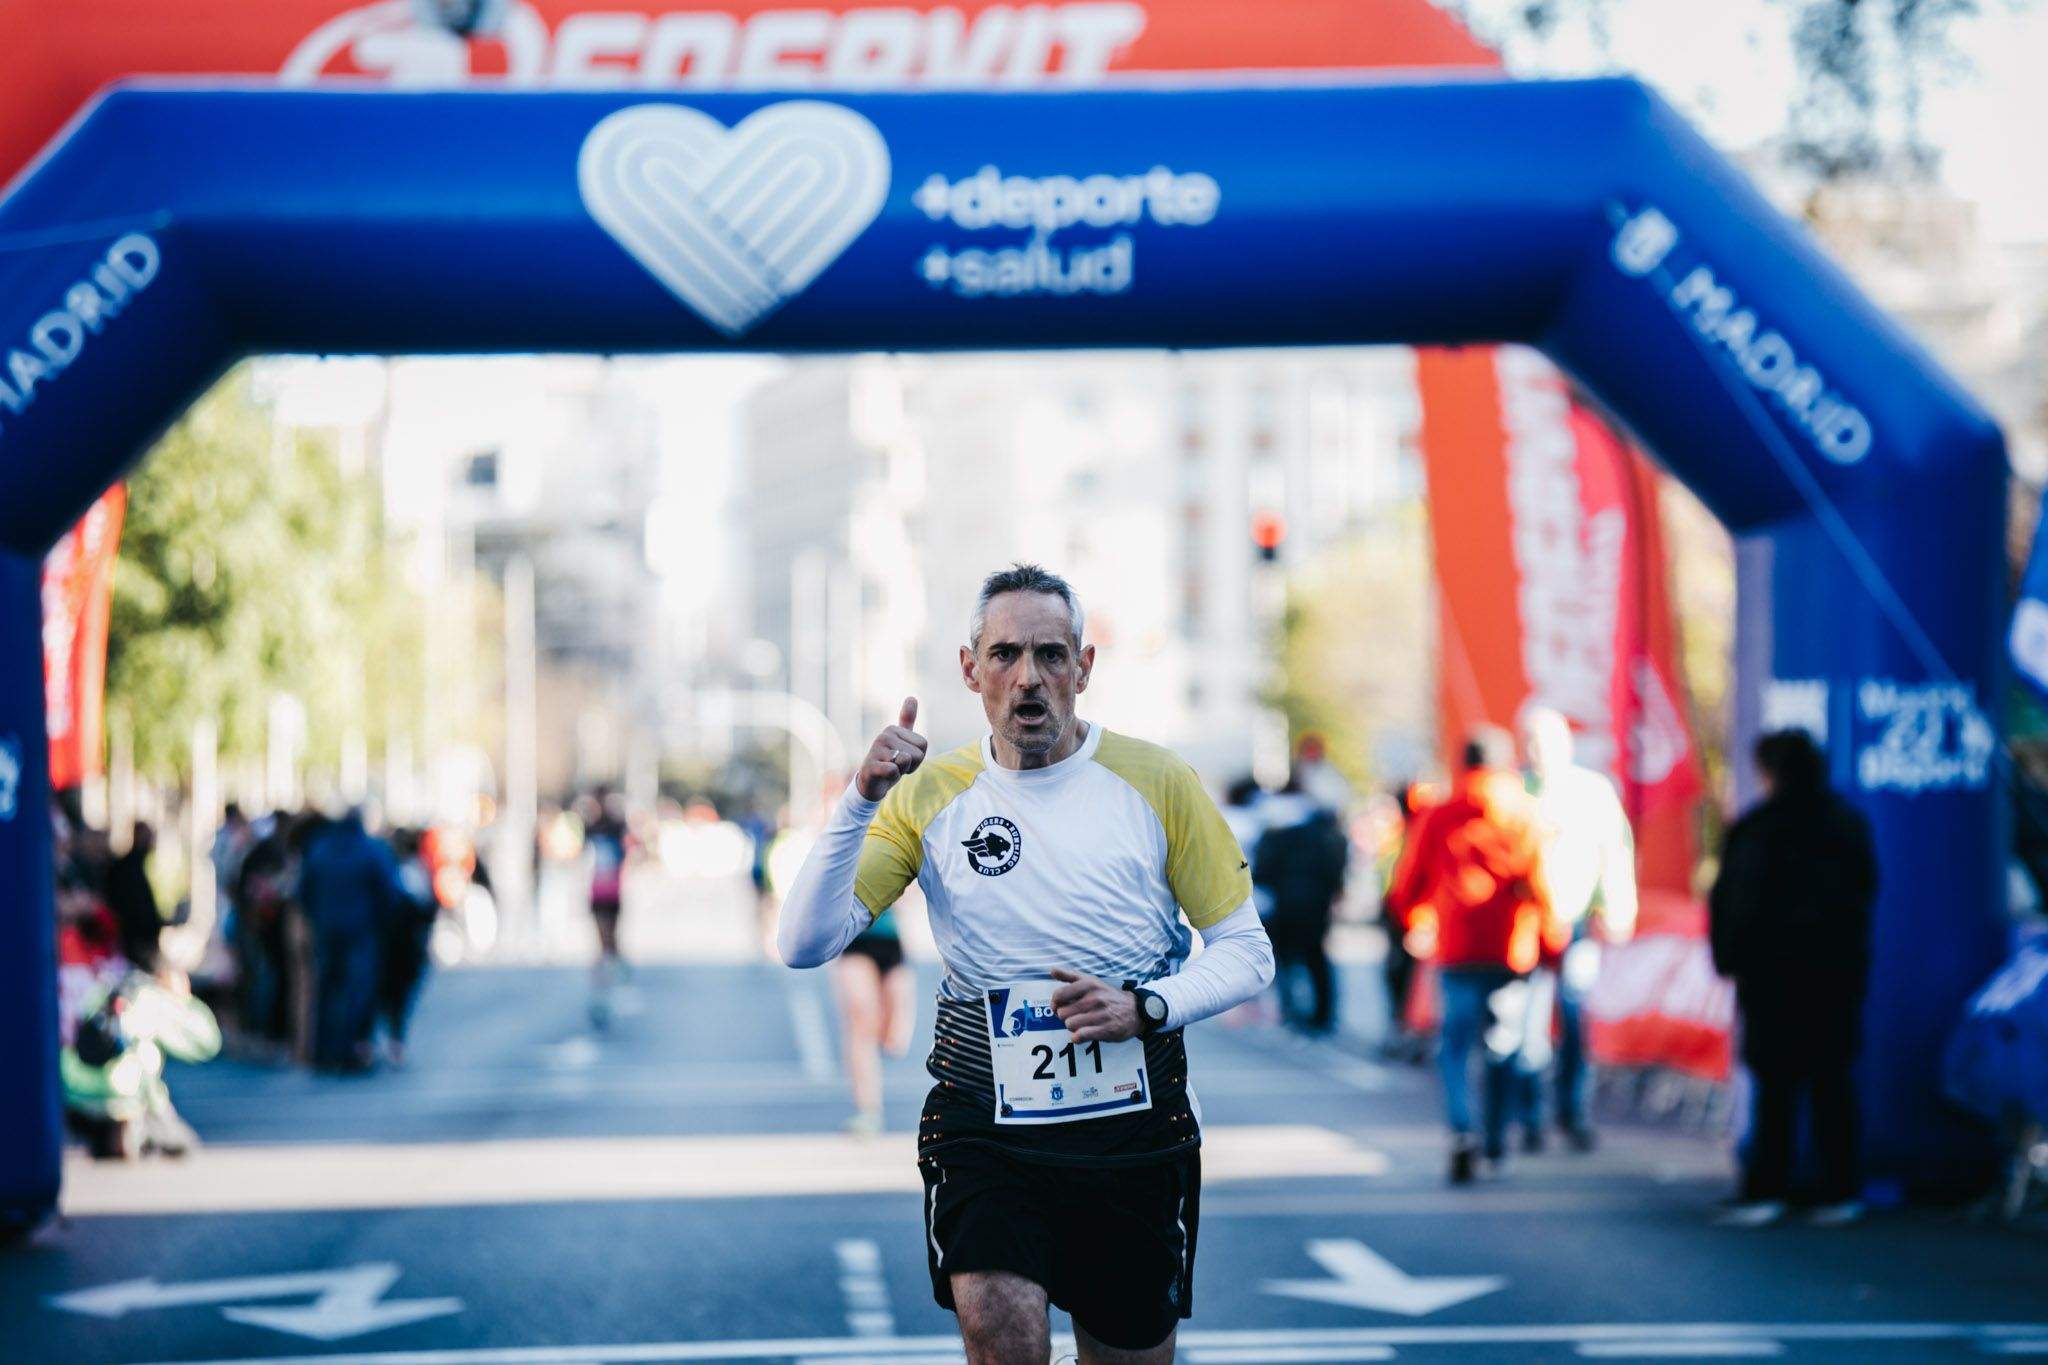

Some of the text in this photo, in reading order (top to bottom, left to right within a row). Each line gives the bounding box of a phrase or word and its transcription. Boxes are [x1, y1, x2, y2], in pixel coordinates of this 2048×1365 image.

[1672, 267, 1871, 464] MADRID
[977, 818, 1020, 874] TIGERS RUNNING CLUB
[1031, 1040, 1103, 1080] 211
